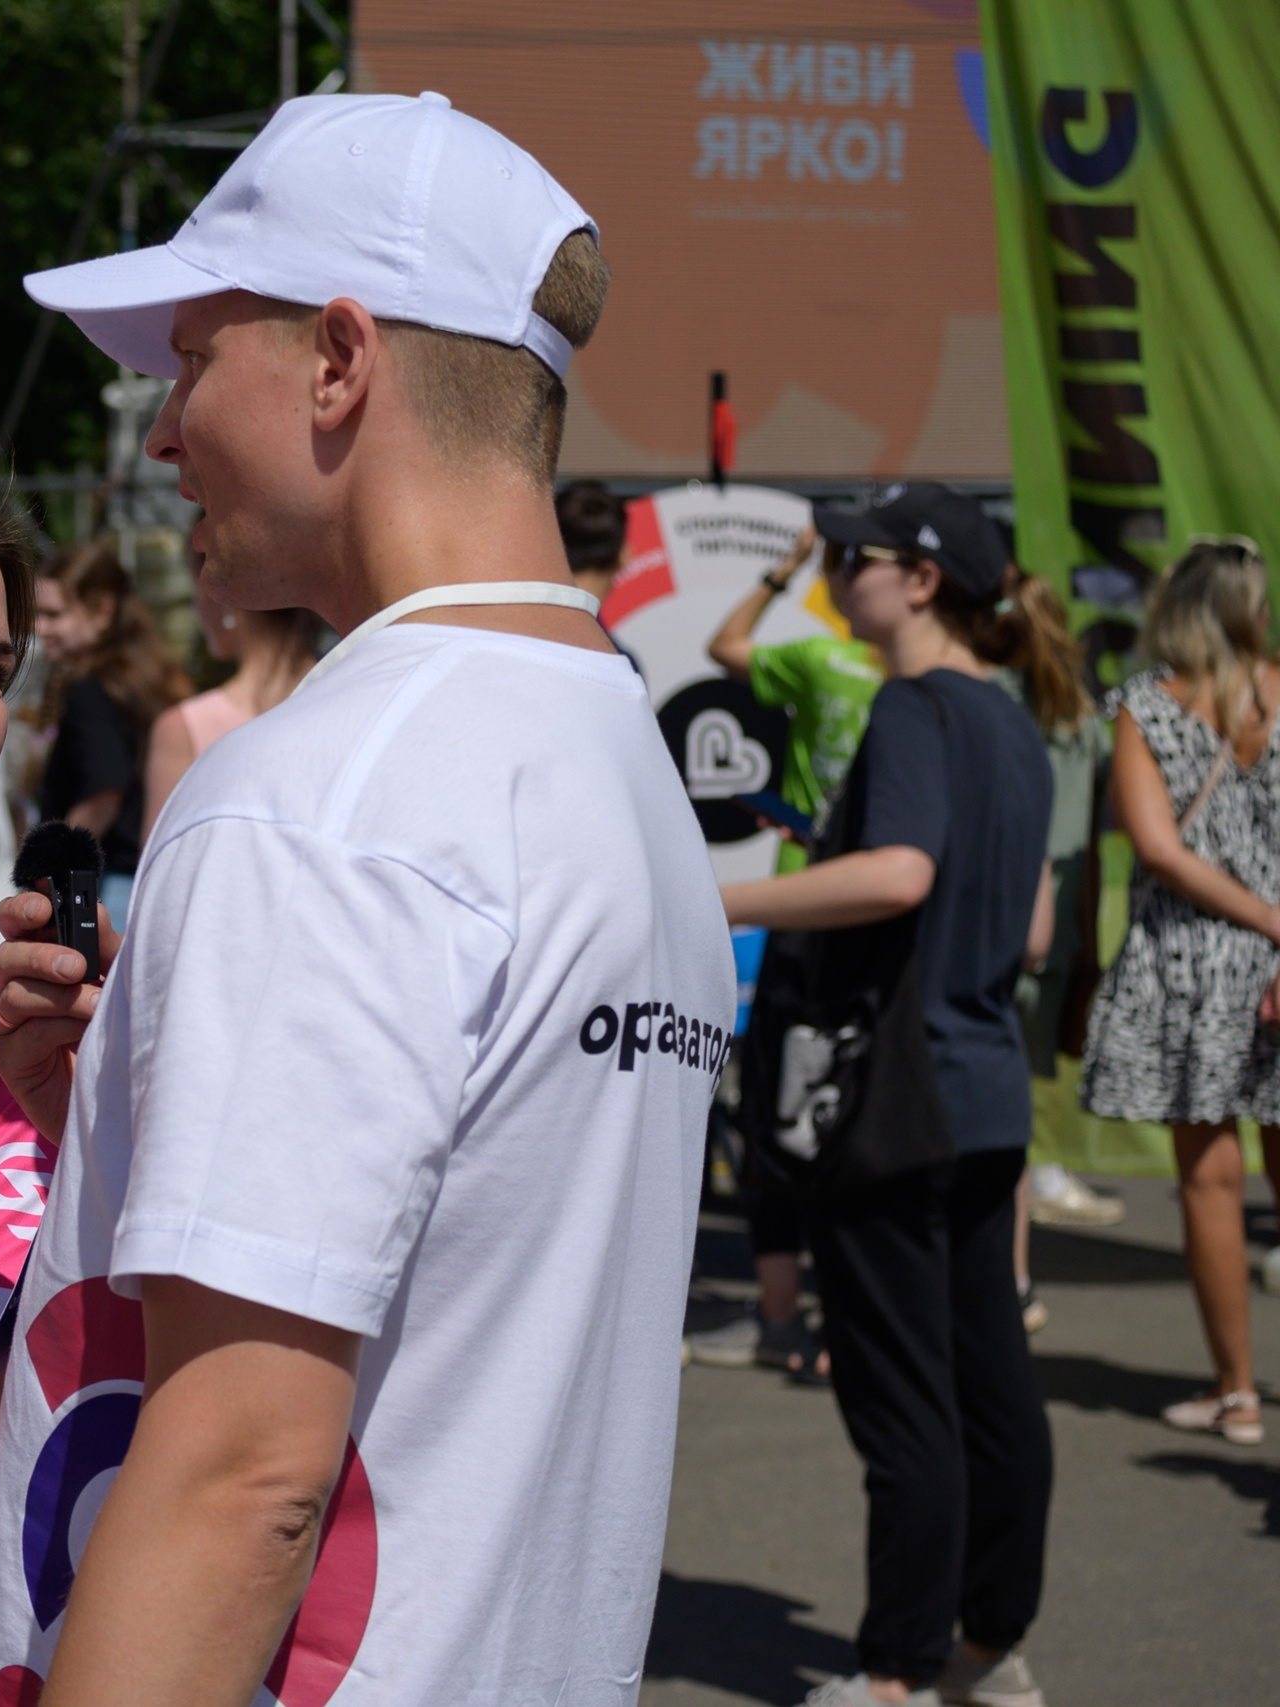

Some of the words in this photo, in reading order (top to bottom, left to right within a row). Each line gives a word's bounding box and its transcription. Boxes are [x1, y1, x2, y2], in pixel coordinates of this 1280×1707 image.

[695, 39, 915, 108] ЖИВИ
[692, 116, 907, 184] ЯРКО!
[675, 514, 802, 542] СПОРТИВНО
